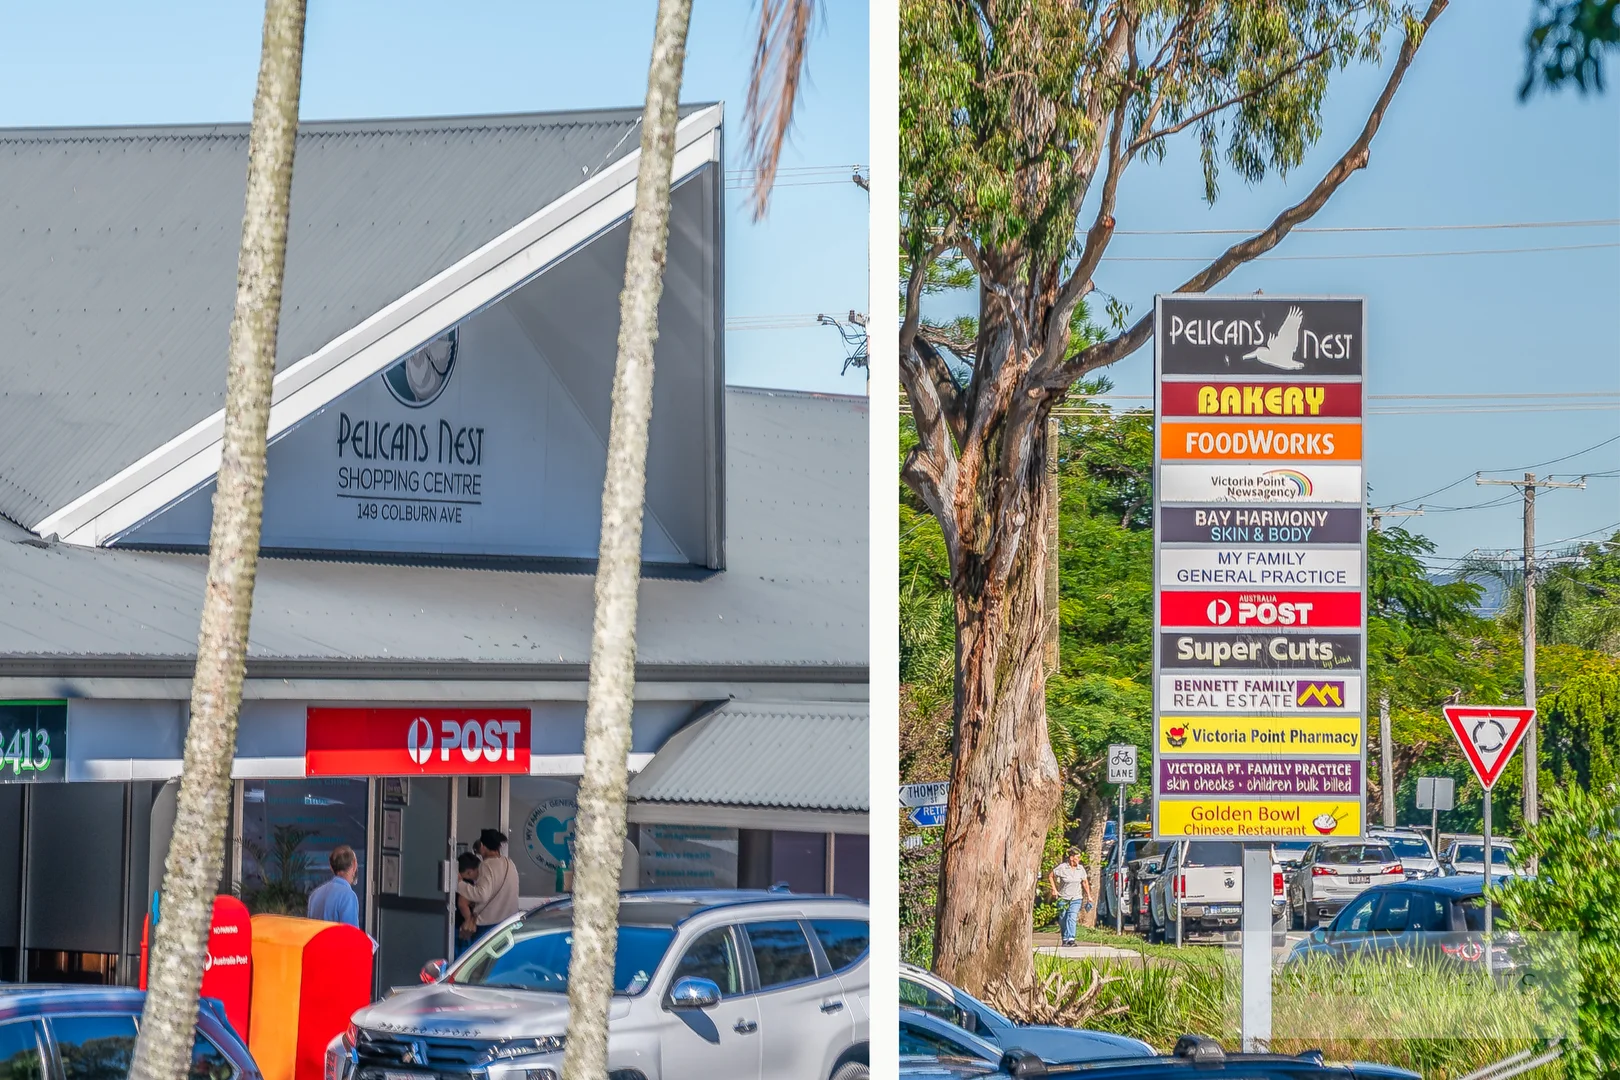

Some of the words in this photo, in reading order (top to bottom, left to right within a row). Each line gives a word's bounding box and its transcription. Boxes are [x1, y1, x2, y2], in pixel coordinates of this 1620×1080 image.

[1197, 385, 1325, 416] BAKERY
[338, 466, 420, 492] SHOPPING
[423, 471, 482, 496] CENTRE
[1211, 475, 1254, 487] Victoria
[1256, 476, 1286, 487] Point
[1226, 486, 1297, 499] Newsagency
[357, 503, 378, 520] 149
[381, 503, 437, 523] COLBURN
[439, 506, 463, 524] AVE
[1195, 510, 1232, 526] BAY
[1236, 510, 1329, 527] HARMONY
[1210, 526, 1249, 542] SKIN
[1253, 527, 1264, 542] &
[1268, 527, 1313, 542] BODY
[1218, 551, 1245, 566] MY
[1247, 551, 1307, 566] FAMILY
[1176, 569, 1258, 583] GENERAL
[1261, 569, 1347, 584] PRACTICE
[1239, 594, 1278, 603] AUSTRALIA
[1239, 602, 1314, 625] POST
[1177, 636, 1264, 667] Super
[1268, 636, 1334, 662] Cuts
[1174, 679, 1239, 693] BENNETT
[1244, 680, 1296, 693] FAMILY
[1173, 693, 1219, 708] REAL
[1226, 694, 1293, 708] ESTATE
[441, 719, 521, 763] POST
[1192, 728, 1247, 744] Victoria
[1250, 728, 1287, 744] Point
[1289, 727, 1359, 748] Pharmacy
[1110, 769, 1134, 779] LANE
[1166, 762, 1224, 775] VICTORIA
[1227, 762, 1245, 775] PT.
[1247, 763, 1292, 776] FAMILY
[1294, 763, 1352, 776] PRACTICE
[1166, 776, 1190, 791] skin
[1193, 776, 1235, 792] checks
[1246, 776, 1292, 792] children
[1295, 777, 1320, 792] bulk
[1323, 777, 1352, 792] billed
[930, 796, 938, 804] ST
[1190, 805, 1253, 822] Golden
[1258, 805, 1301, 822] Bowl
[1183, 823, 1234, 836] Chinese
[1237, 823, 1307, 837] Restaurant
[236, 954, 248, 965] Post
